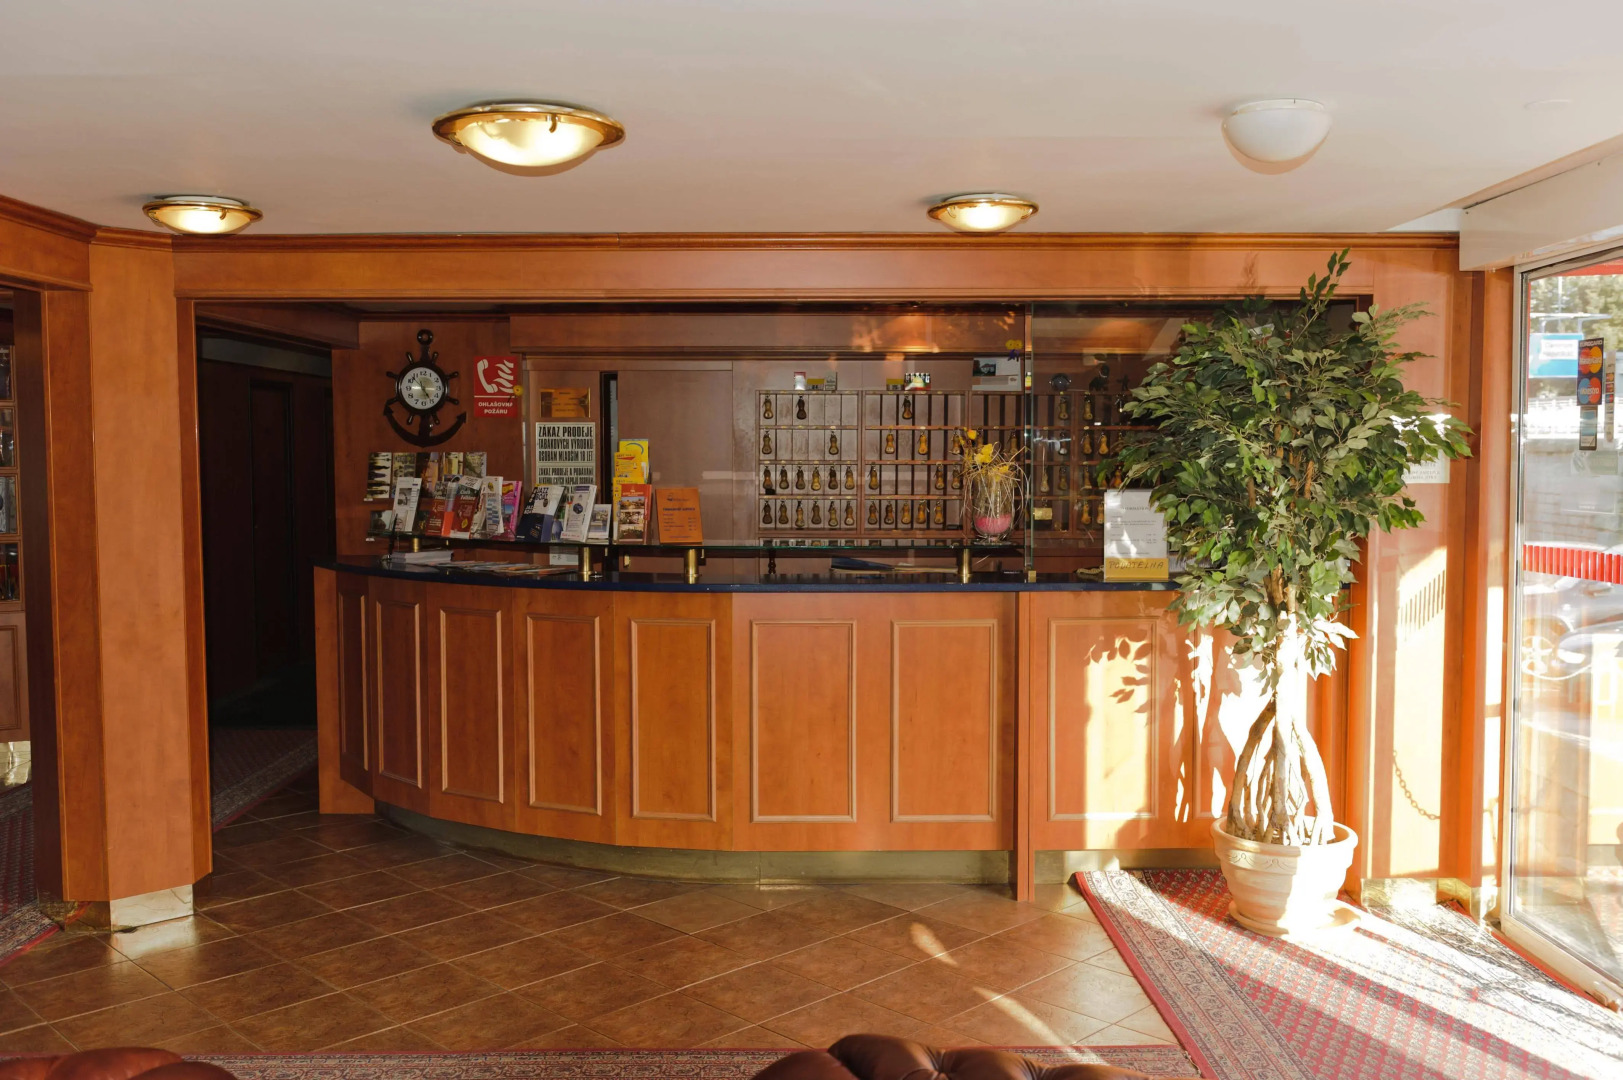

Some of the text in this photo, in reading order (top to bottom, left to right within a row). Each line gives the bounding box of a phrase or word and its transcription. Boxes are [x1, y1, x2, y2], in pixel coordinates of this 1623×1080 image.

[538, 425, 593, 438] ZÁKAZ PRODEJE
[580, 451, 586, 461] 18
